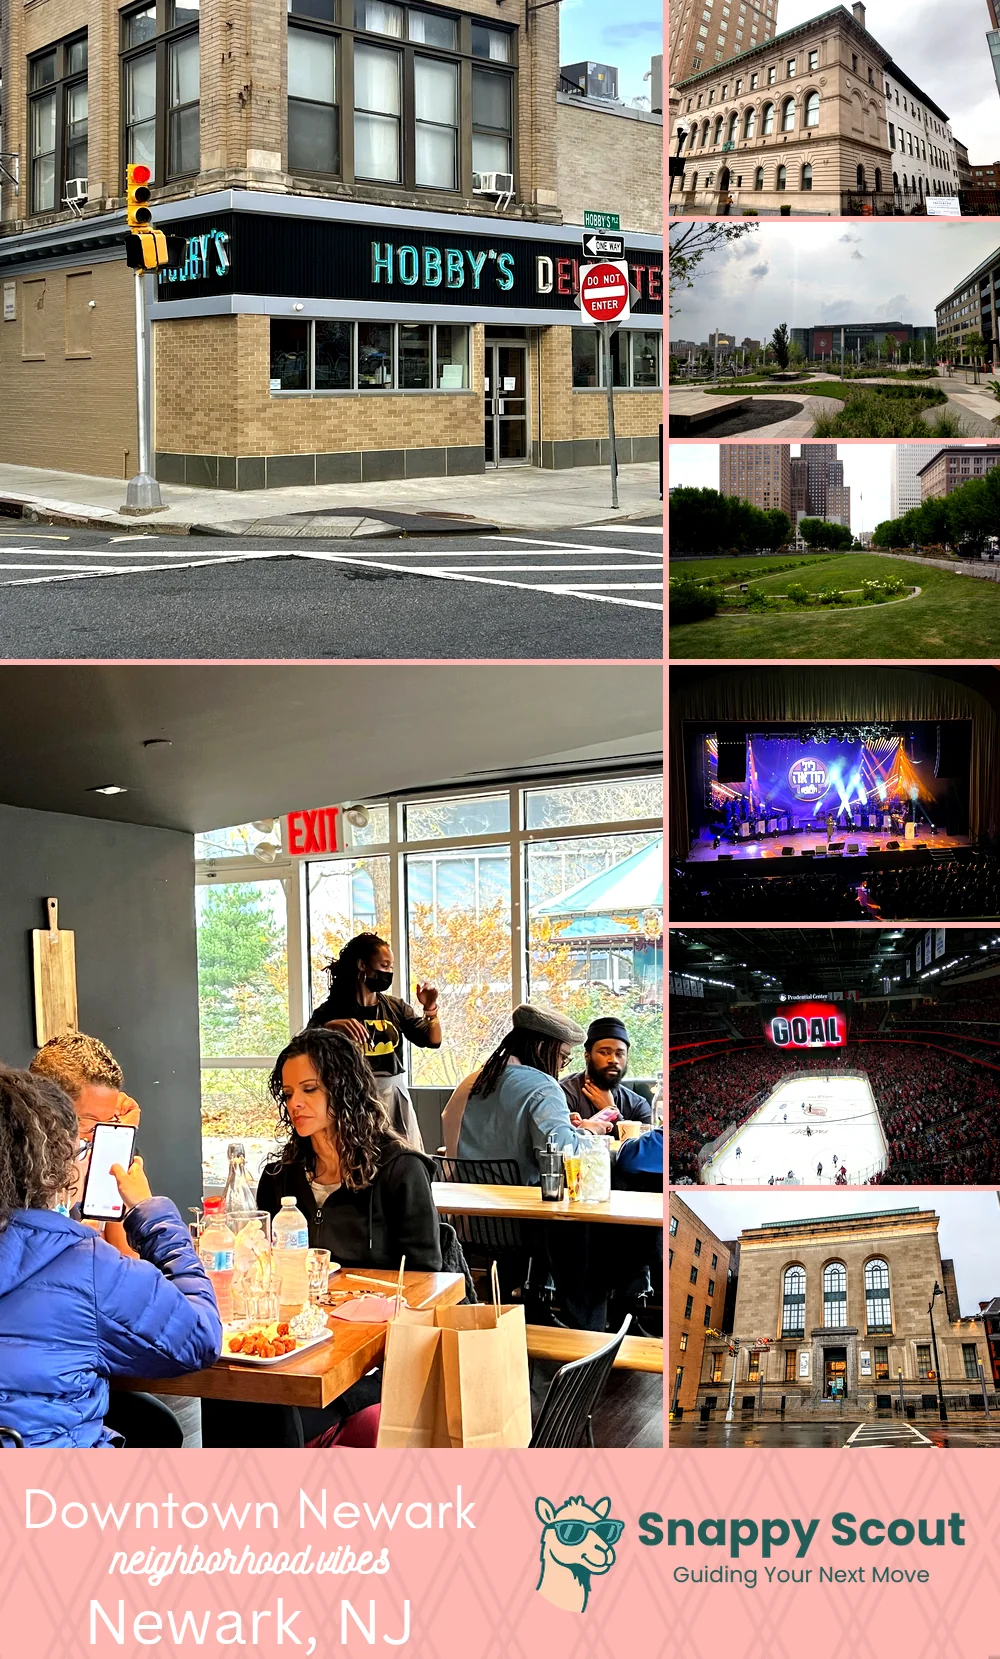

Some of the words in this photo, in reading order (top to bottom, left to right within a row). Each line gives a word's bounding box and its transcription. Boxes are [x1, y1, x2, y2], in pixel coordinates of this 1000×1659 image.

[585, 213, 611, 228] HOBBY'S
[596, 241, 608, 251] ONE
[609, 242, 621, 252] WAY
[371, 241, 515, 291] HOBBY'S
[587, 276, 599, 286] DO
[603, 273, 621, 285] NOT
[591, 300, 619, 311] ENTER
[287, 807, 339, 855] EXIT
[771, 1016, 842, 1046] GOAL
